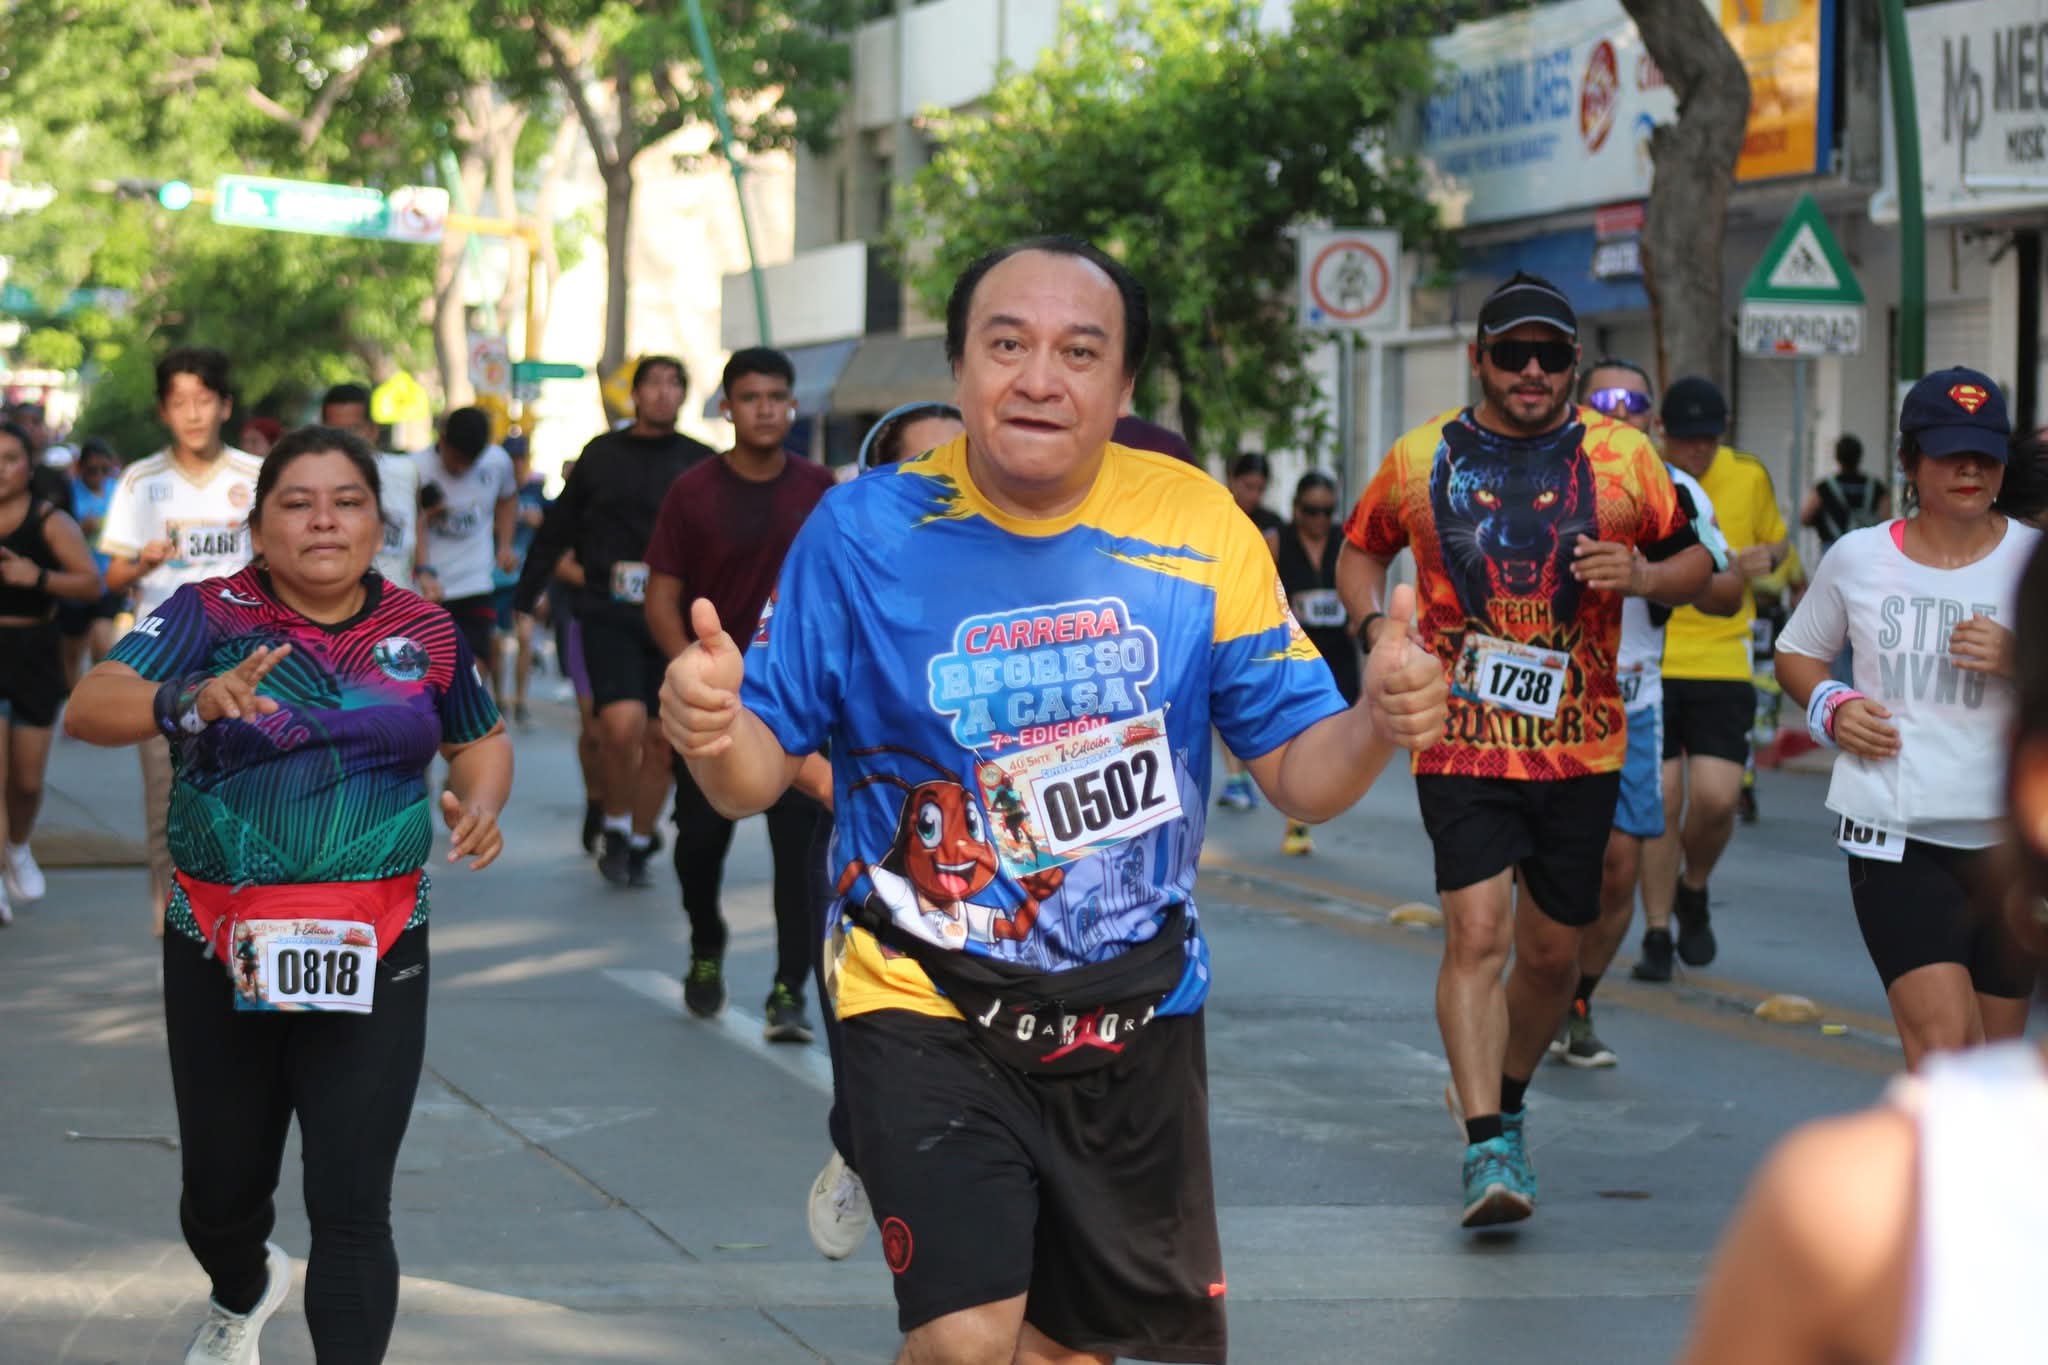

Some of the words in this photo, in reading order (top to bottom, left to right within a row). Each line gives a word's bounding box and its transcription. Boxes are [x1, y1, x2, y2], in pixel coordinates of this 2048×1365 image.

[1746, 314, 1857, 346] PRIORIDAD
[965, 607, 1121, 655] CARRERA
[1489, 600, 1551, 626] TEAM
[941, 637, 1146, 701] REGRESO
[1490, 661, 1554, 705] 1738
[963, 698, 996, 736] A
[1008, 677, 1134, 727] CASA
[1043, 749, 1167, 843] 0502
[277, 948, 362, 997] 0818
